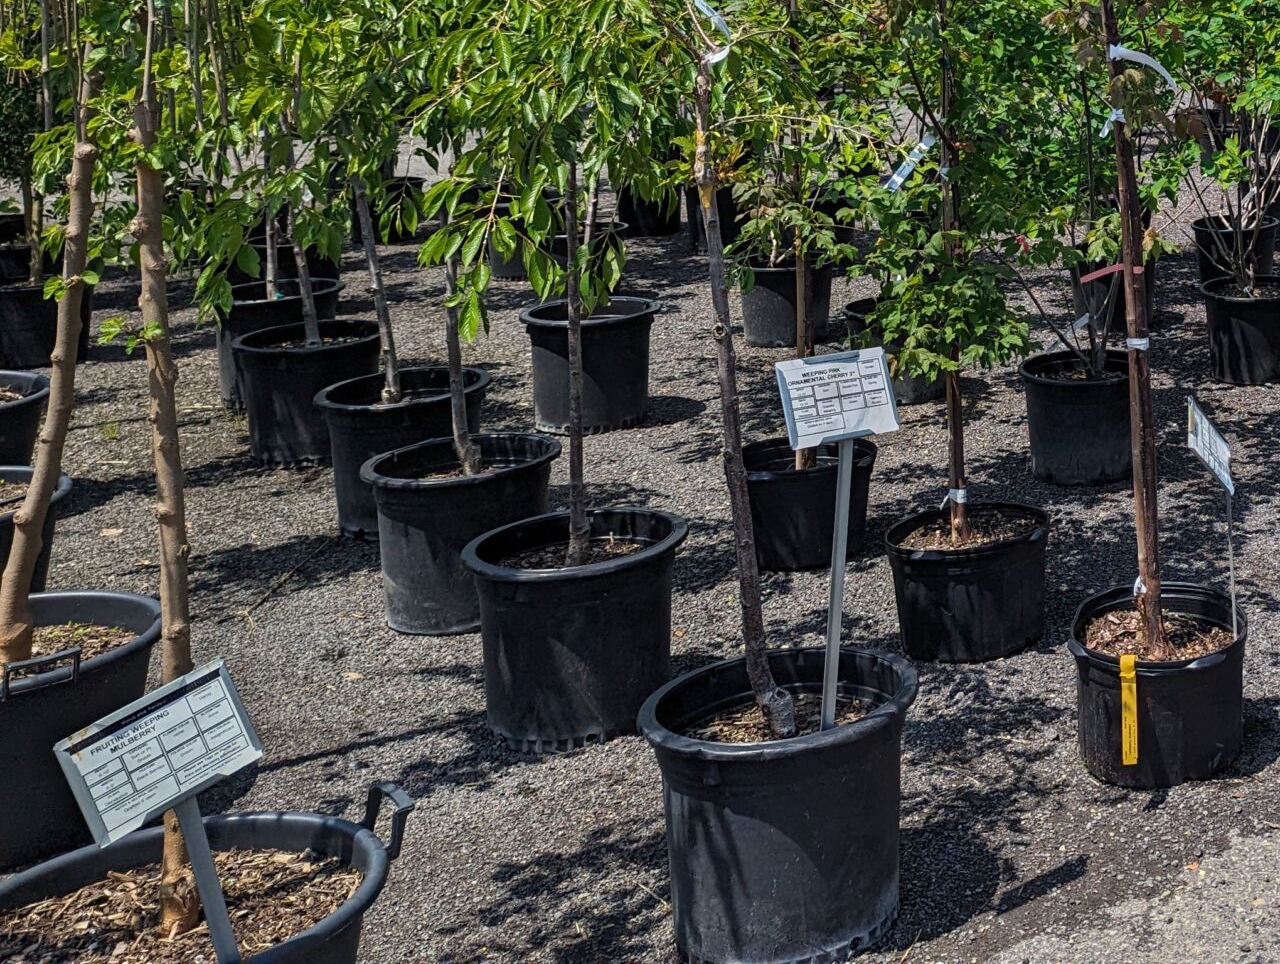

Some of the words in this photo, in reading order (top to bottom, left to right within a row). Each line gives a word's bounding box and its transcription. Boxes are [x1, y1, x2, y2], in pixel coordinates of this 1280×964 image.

[787, 375, 826, 386] ORNAMENTAL
[826, 371, 849, 379] CHERRY
[801, 369, 827, 378] WEEPING
[89, 730, 130, 756] FRUITING
[130, 709, 170, 734] WEEPING
[109, 723, 157, 754] MULBERRY
